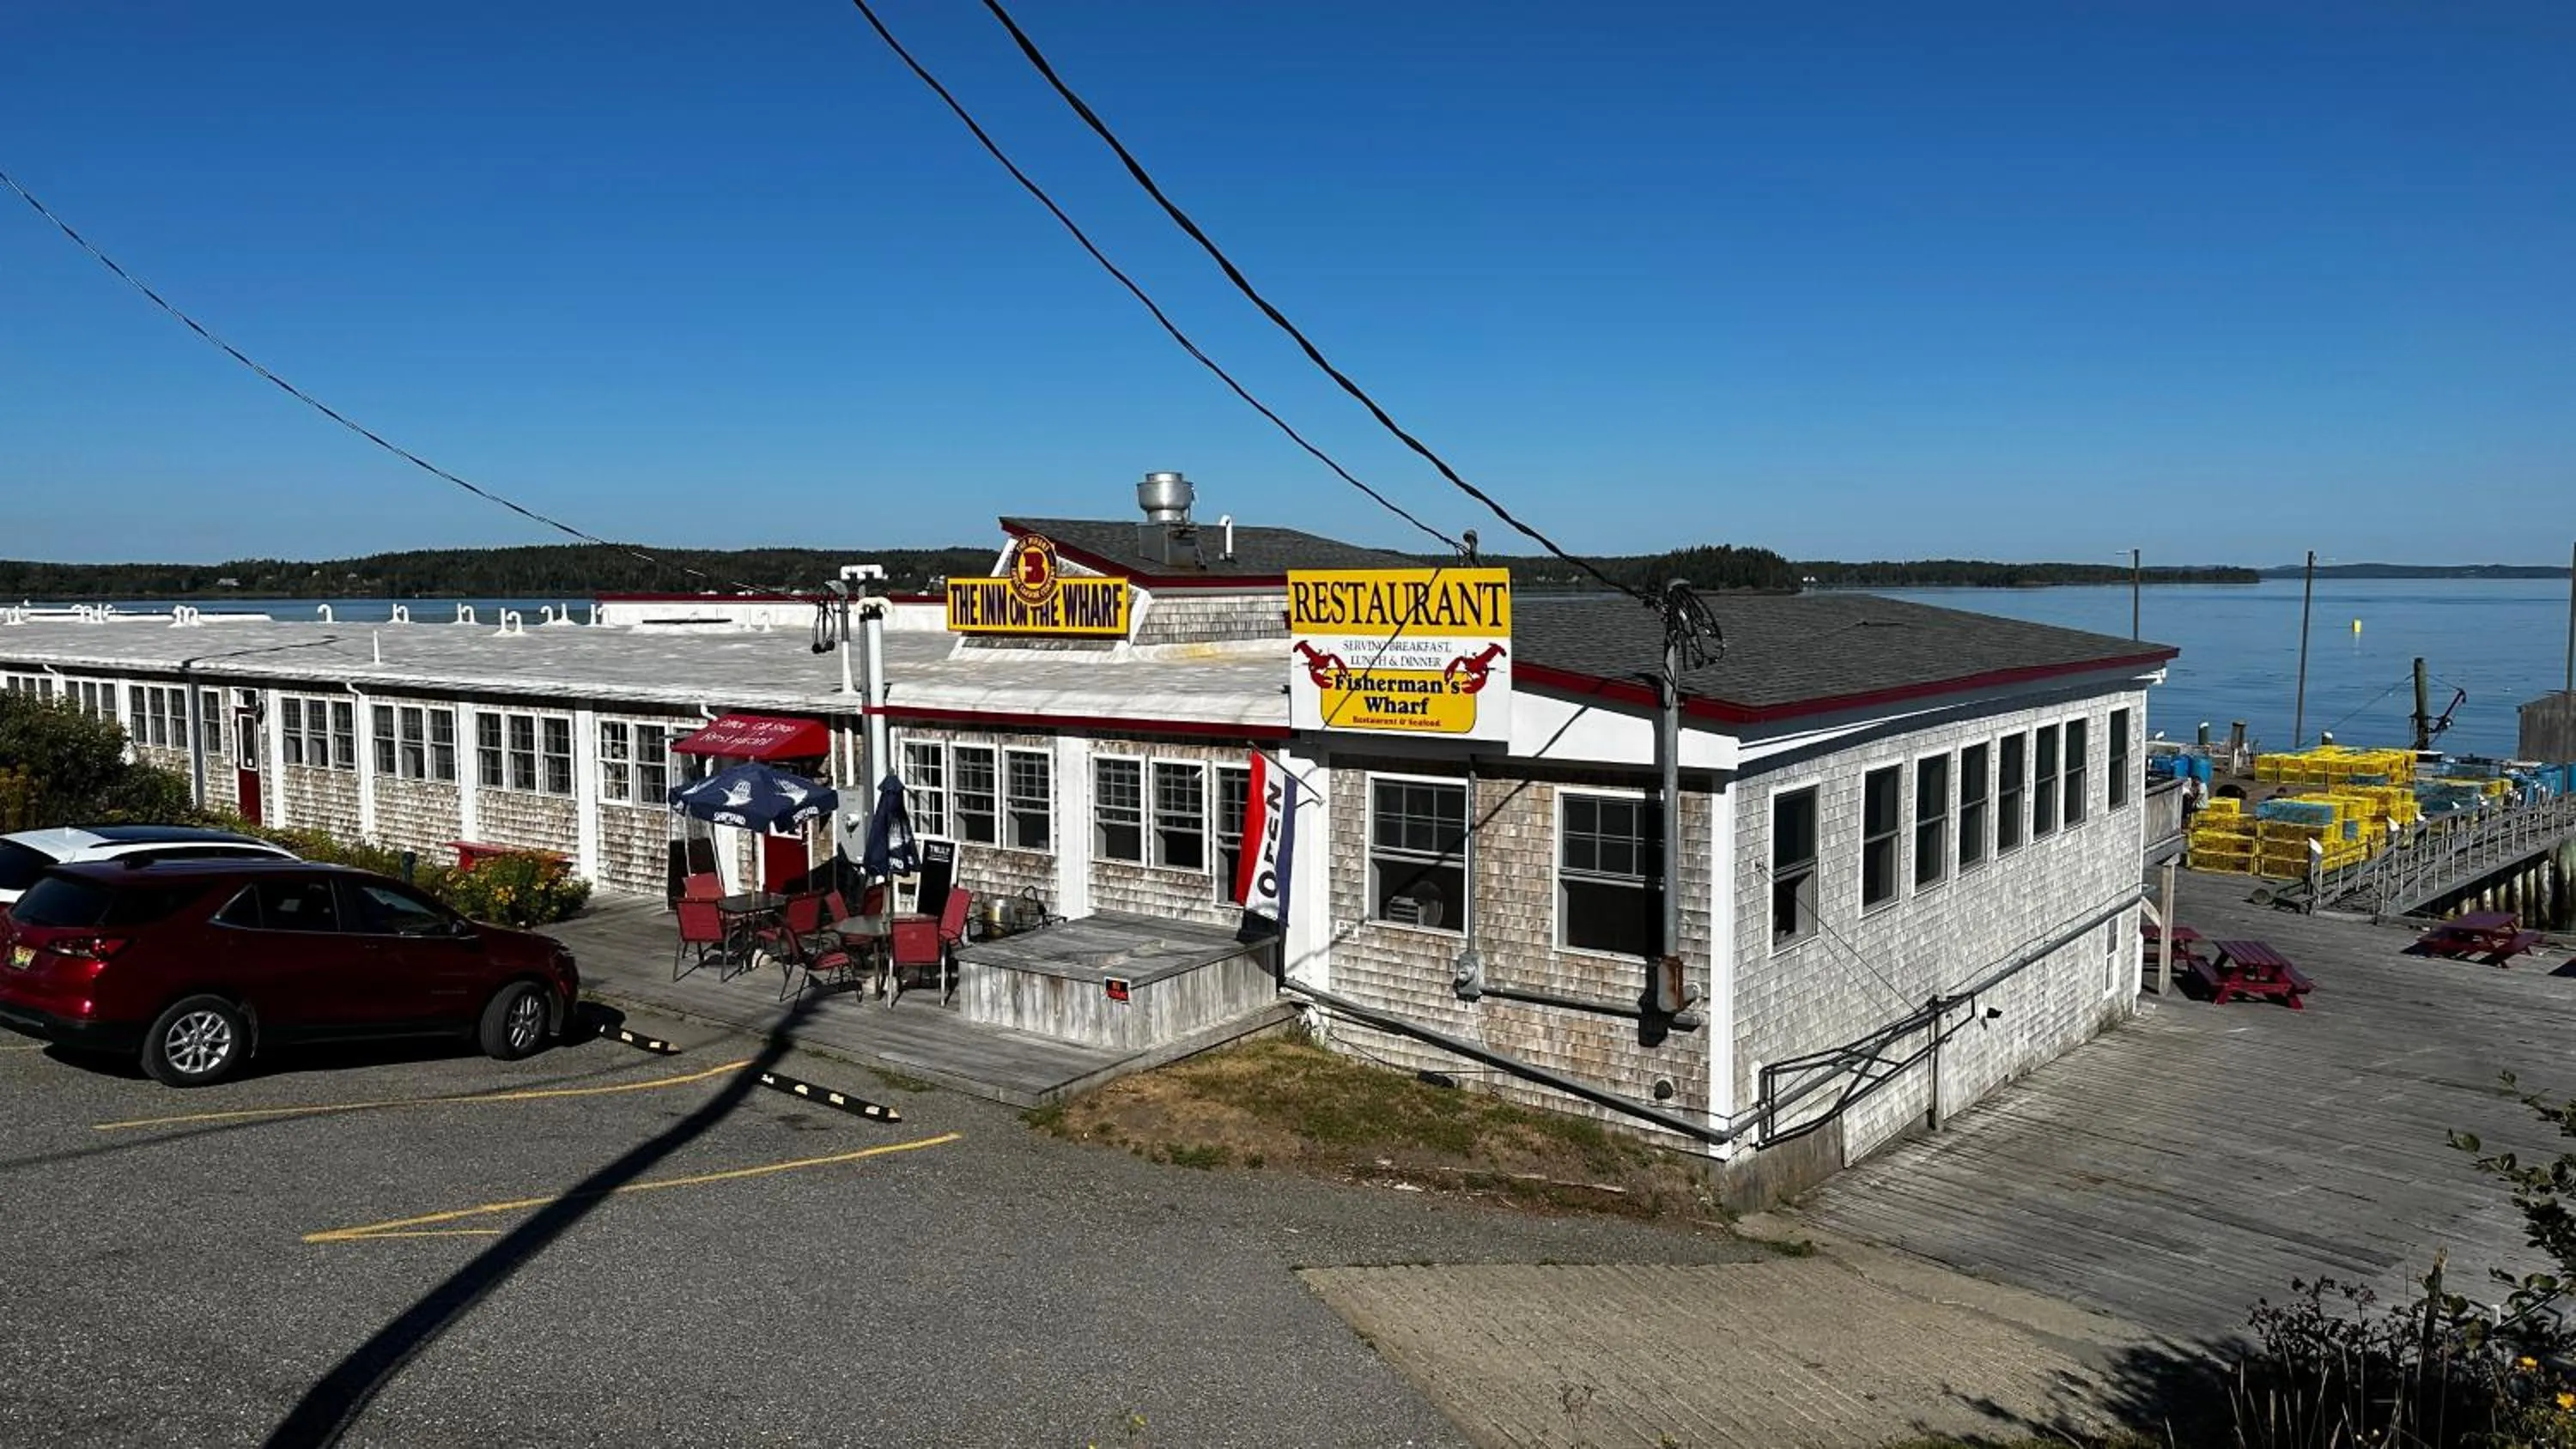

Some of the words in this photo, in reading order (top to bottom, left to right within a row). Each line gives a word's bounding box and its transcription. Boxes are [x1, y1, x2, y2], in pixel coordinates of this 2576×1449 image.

[950, 584, 978, 625] THE
[981, 584, 1007, 626] INN
[1009, 593, 1029, 626] ON
[1030, 592, 1060, 627] THE
[1062, 583, 1122, 627] WHARF
[1291, 581, 1507, 627] RESTAURANT
[1351, 655, 1388, 667] LUNCH
[1388, 655, 1399, 667] &
[1400, 655, 1443, 668] DINNER
[1334, 672, 1461, 695] Fisherman's
[1364, 694, 1430, 715] Wharf
